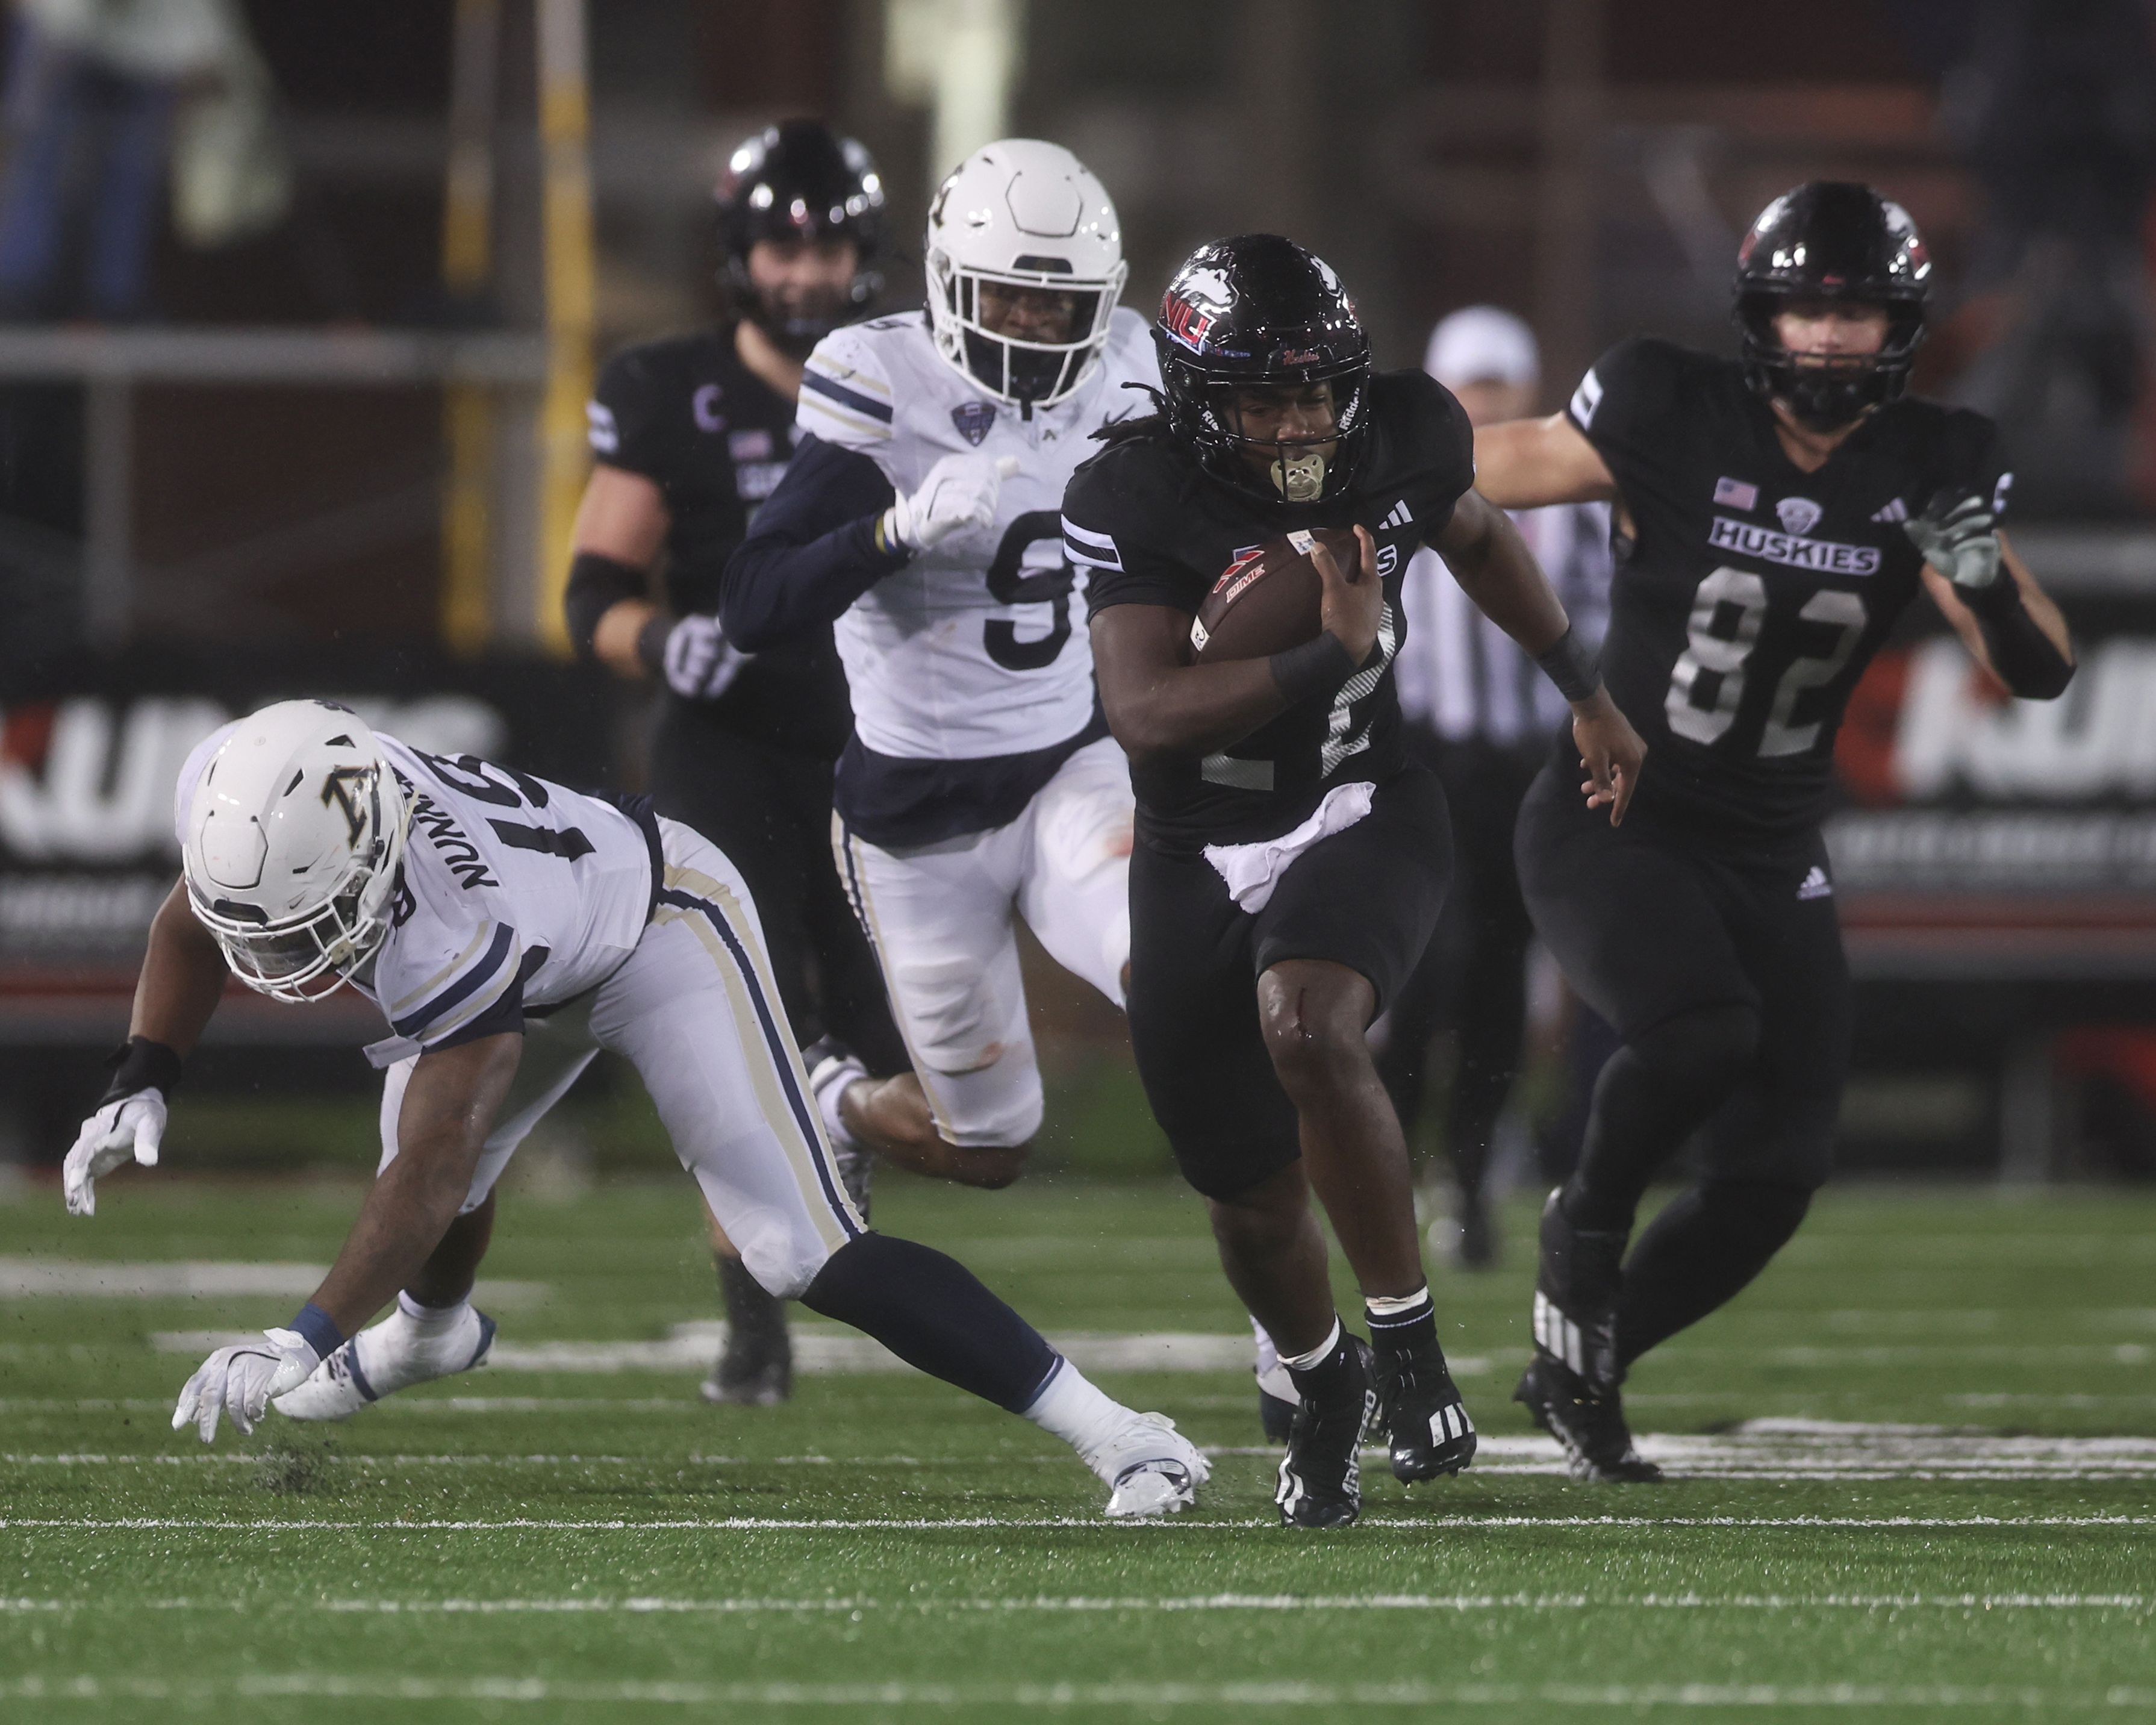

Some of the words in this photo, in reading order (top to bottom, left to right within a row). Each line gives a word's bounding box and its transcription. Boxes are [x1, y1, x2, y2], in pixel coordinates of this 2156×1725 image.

[983, 510, 1077, 672] 9
[1226, 563, 1265, 604] DIME
[1709, 517, 1879, 575] HUSKIES
[1663, 566, 1869, 758] 82
